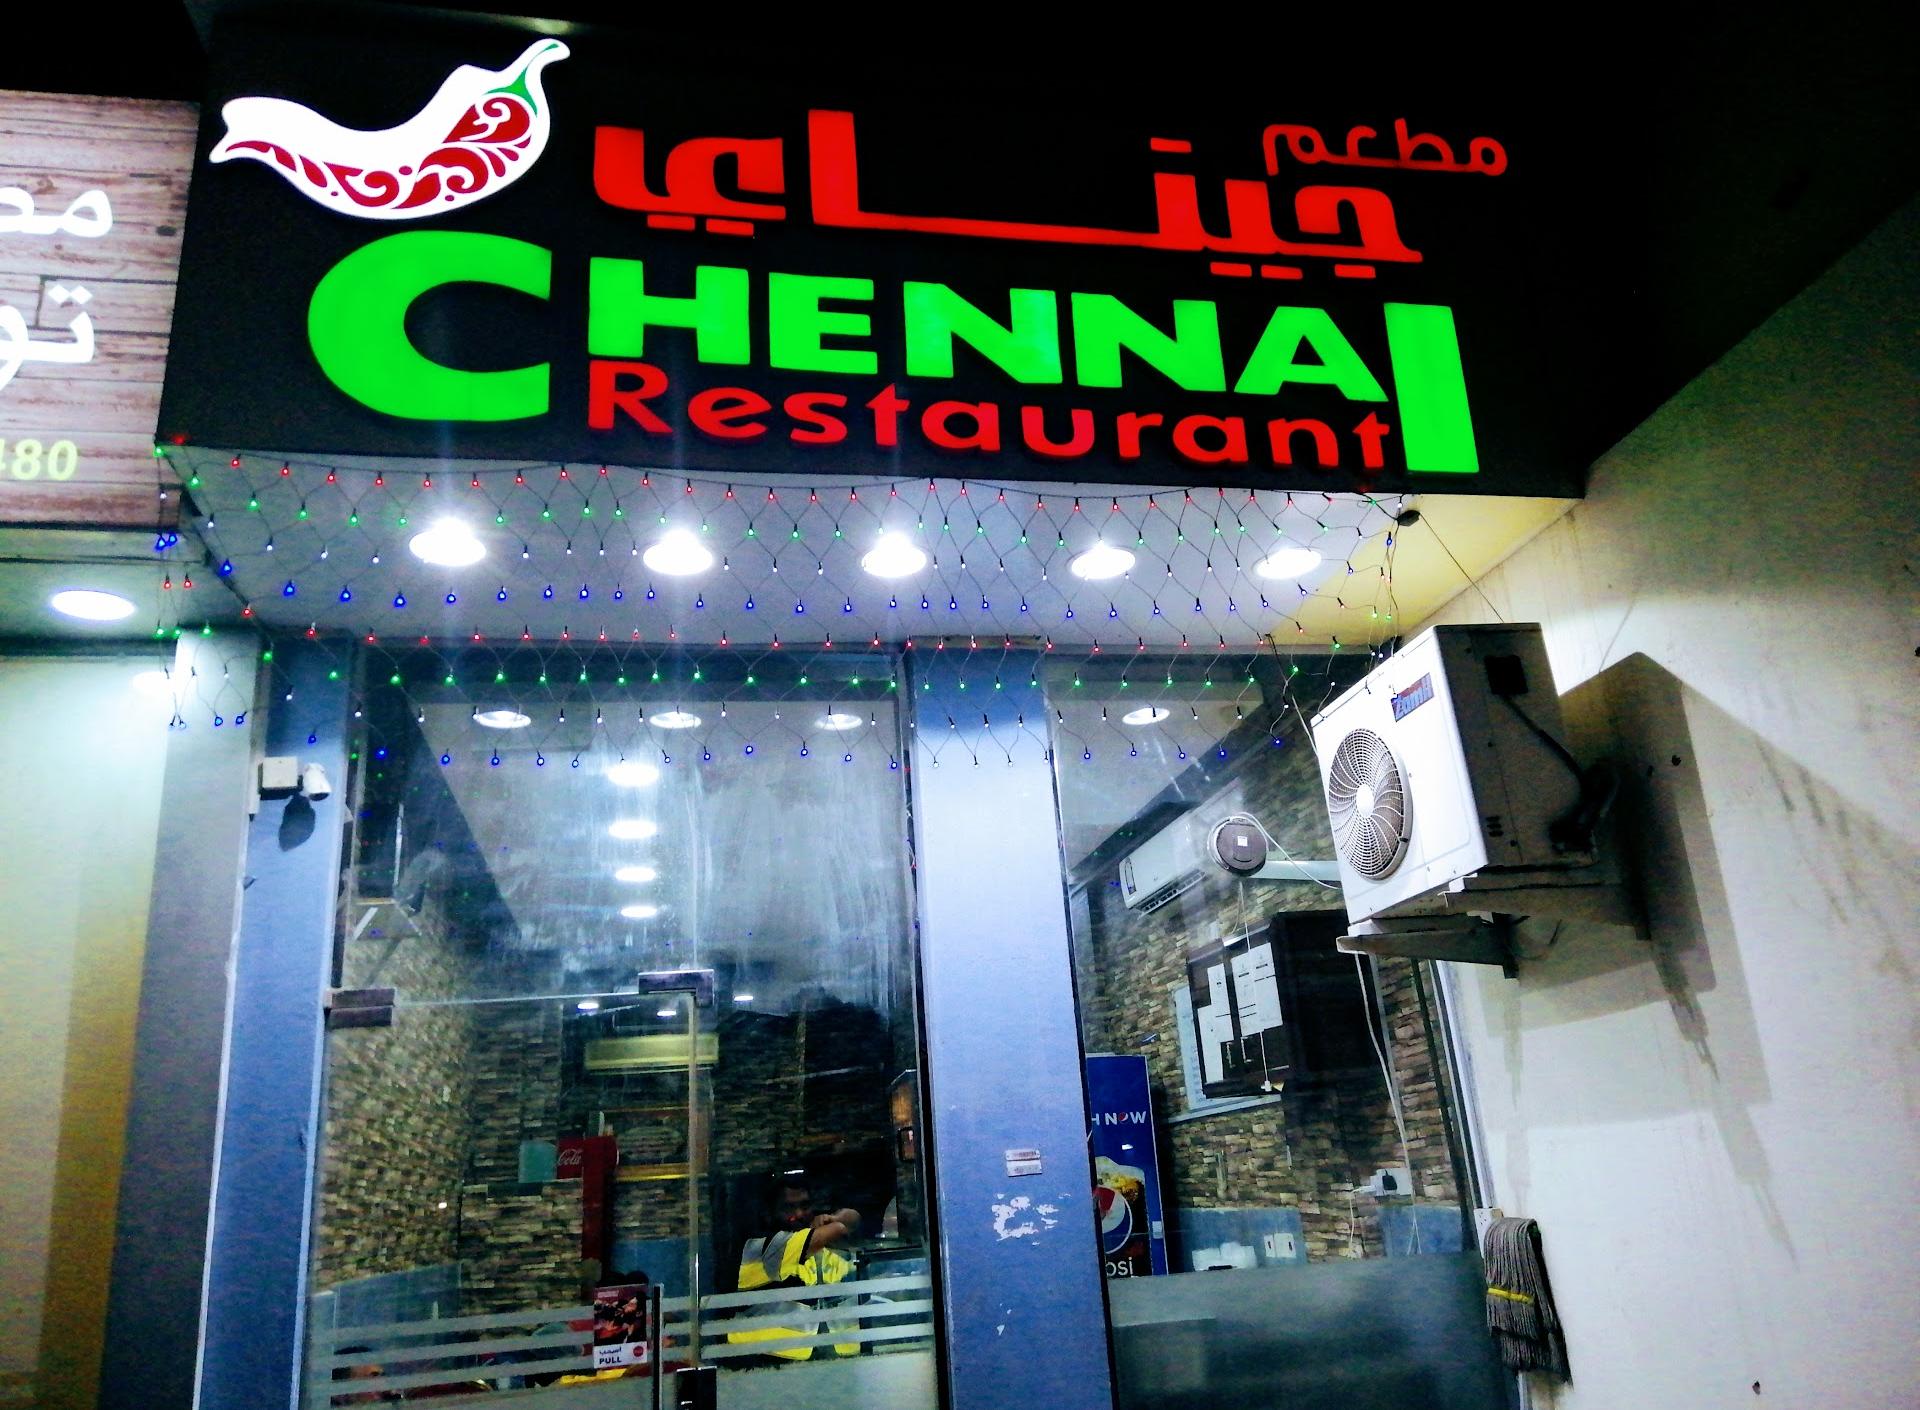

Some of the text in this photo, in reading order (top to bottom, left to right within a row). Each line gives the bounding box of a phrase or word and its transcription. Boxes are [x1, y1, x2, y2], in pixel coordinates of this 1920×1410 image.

[1262, 118, 1508, 176] مطعم
[307, 230, 1480, 474] CHENNAI
[587, 359, 1391, 470] Restaurant
[599, 1356, 622, 1365] PULL
